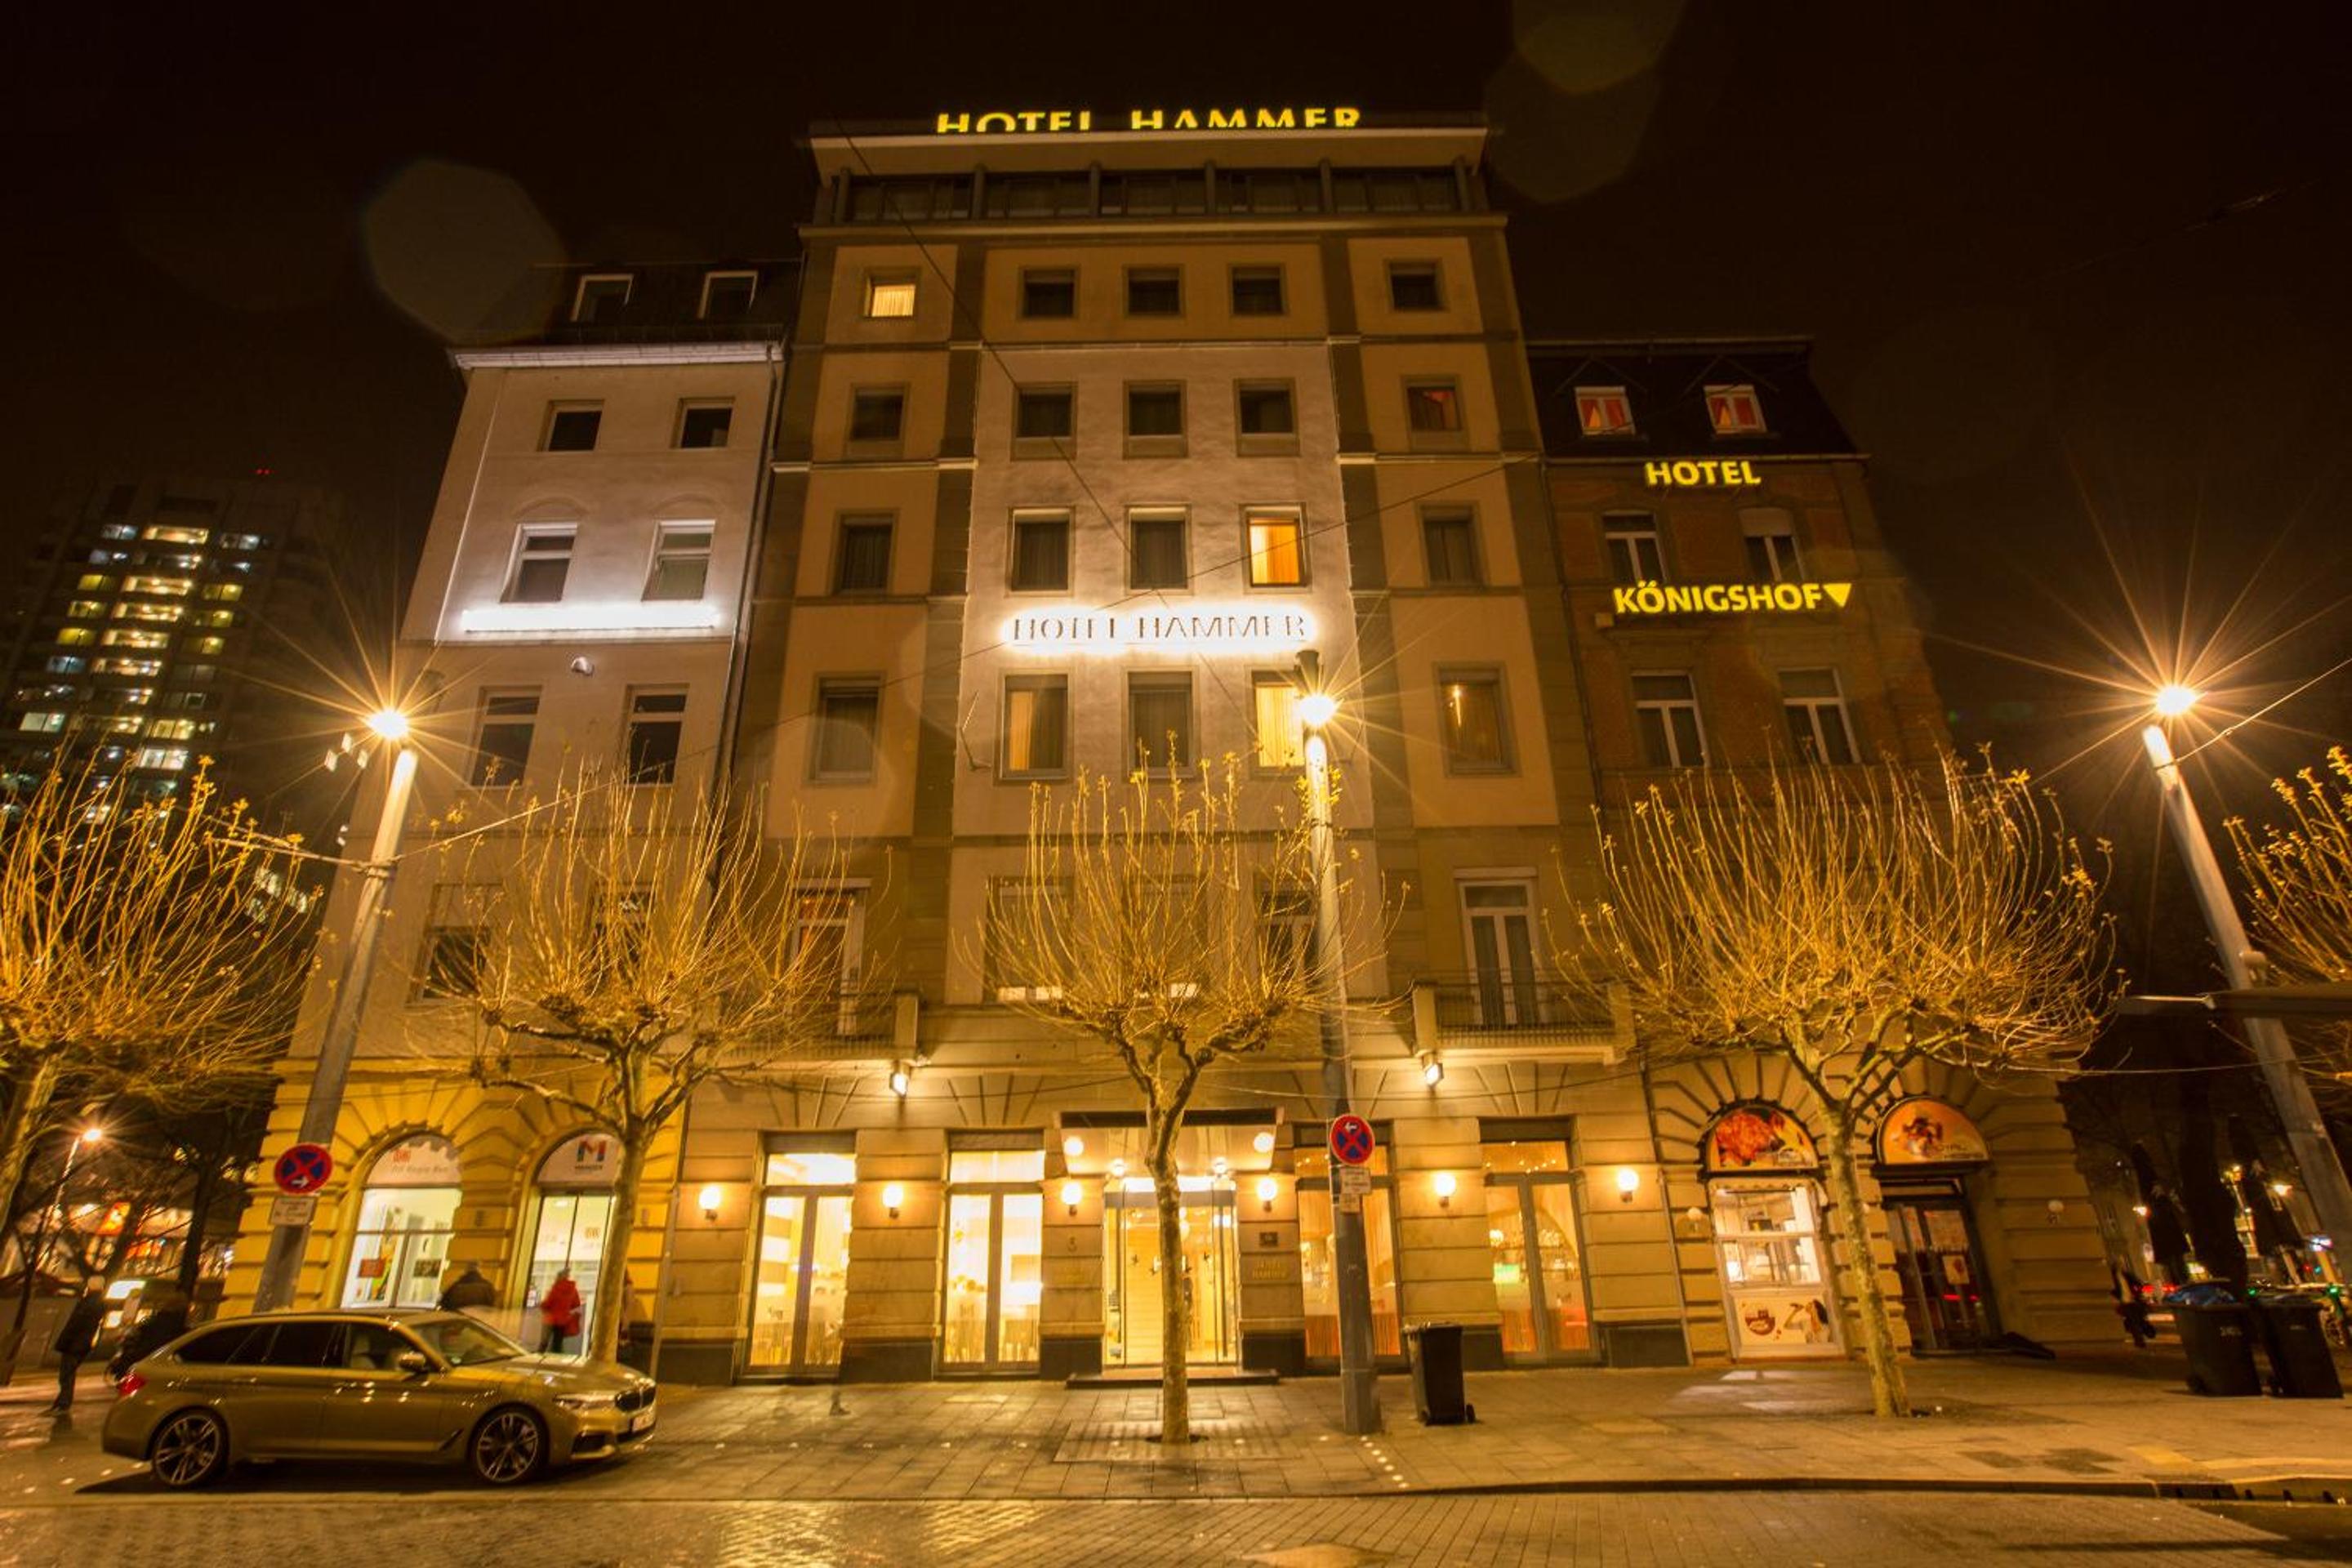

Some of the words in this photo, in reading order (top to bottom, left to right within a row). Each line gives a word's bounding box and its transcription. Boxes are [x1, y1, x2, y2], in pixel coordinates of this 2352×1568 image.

[1131, 107, 1360, 129] HAMMER
[1645, 461, 1761, 486] HOTEL
[1614, 580, 1822, 613] KÖNIGSHOF
[1013, 617, 1115, 640] HOTEL
[1139, 616, 1304, 638] HAMMER
